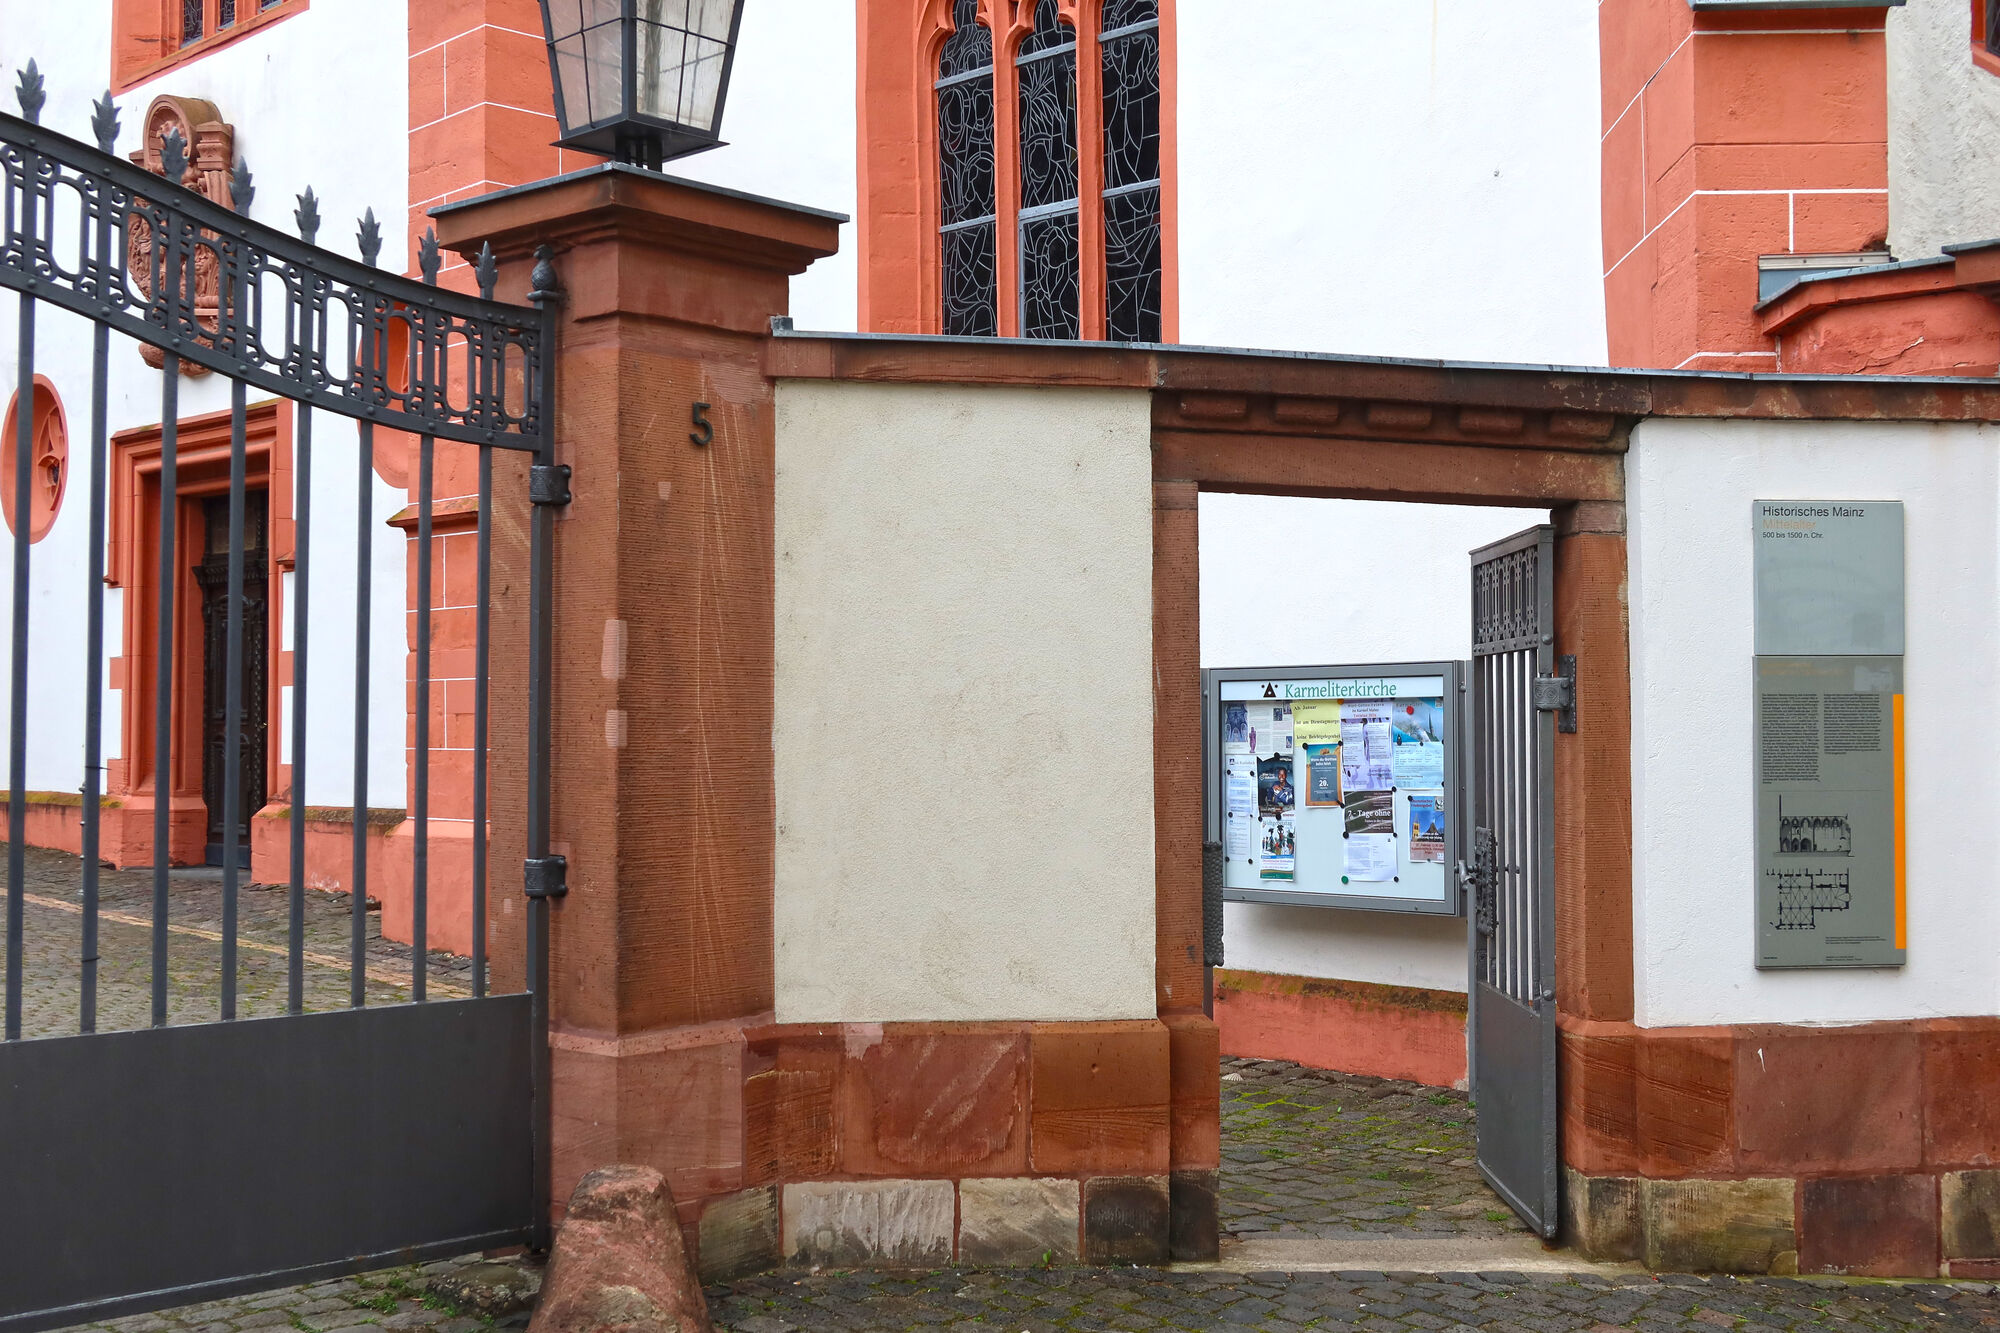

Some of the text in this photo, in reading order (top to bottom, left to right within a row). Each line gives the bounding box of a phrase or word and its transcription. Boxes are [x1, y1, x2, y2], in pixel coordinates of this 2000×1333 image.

[689, 402, 714, 446] 5
[1762, 506, 1865, 517] Historisches Mainz
[1762, 519, 1817, 530] Mittelalter
[1285, 679, 1397, 698] Karmeliterkirche
[1357, 810, 1373, 818] Tage
[1374, 808, 1391, 817] ohne
